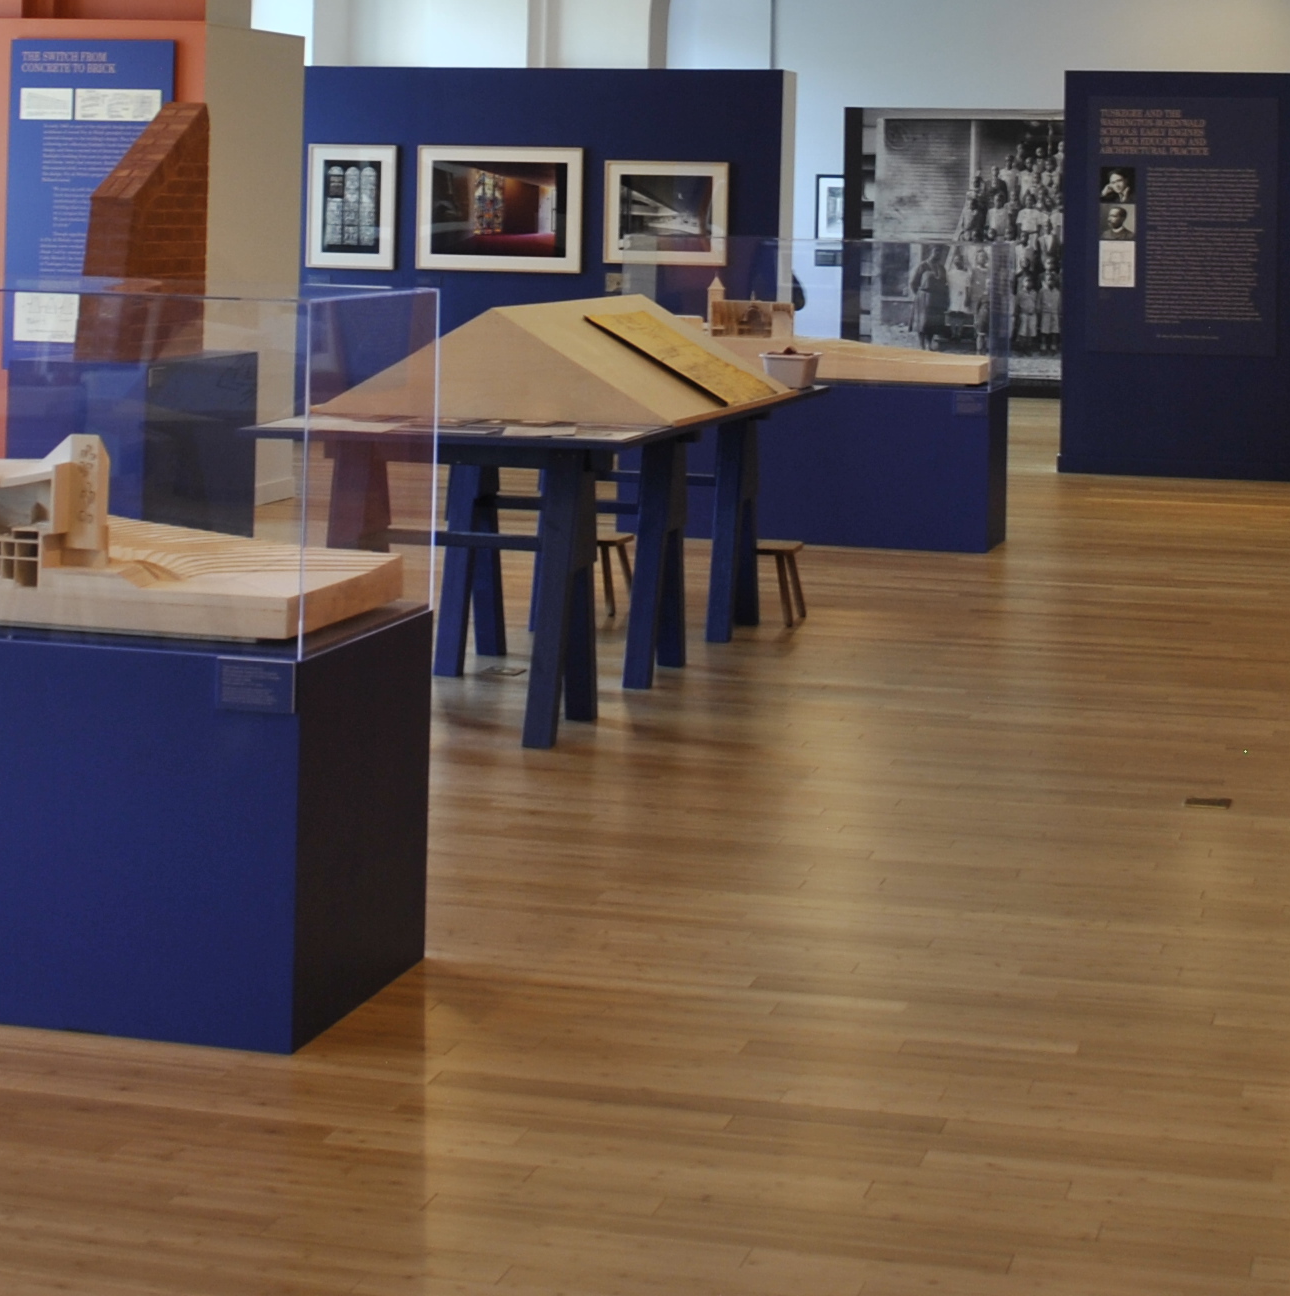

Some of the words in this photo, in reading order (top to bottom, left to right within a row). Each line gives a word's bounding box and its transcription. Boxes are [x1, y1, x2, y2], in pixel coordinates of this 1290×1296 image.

[21, 51, 41, 61] THE
[42, 52, 78, 61] SWITCH
[80, 52, 108, 62] FROM
[21, 63, 71, 73] CONCRETE
[73, 64, 85, 73] TO
[86, 64, 116, 74] BRICK
[1099, 108, 1143, 118] TUSKEGEE
[1144, 109, 1163, 118] AND
[1164, 109, 1182, 118] THE
[1139, 128, 1166, 136] EARLY
[1167, 128, 1205, 137] ENGINES
[1099, 137, 1111, 145] OF
[1112, 137, 1139, 145] BLACK
[1140, 137, 1186, 146] EDUCATION
[1187, 137, 1207, 146] AND
[1099, 146, 1167, 155] ARCHITECTURAL
[1169, 147, 1210, 156] PRACTICE
